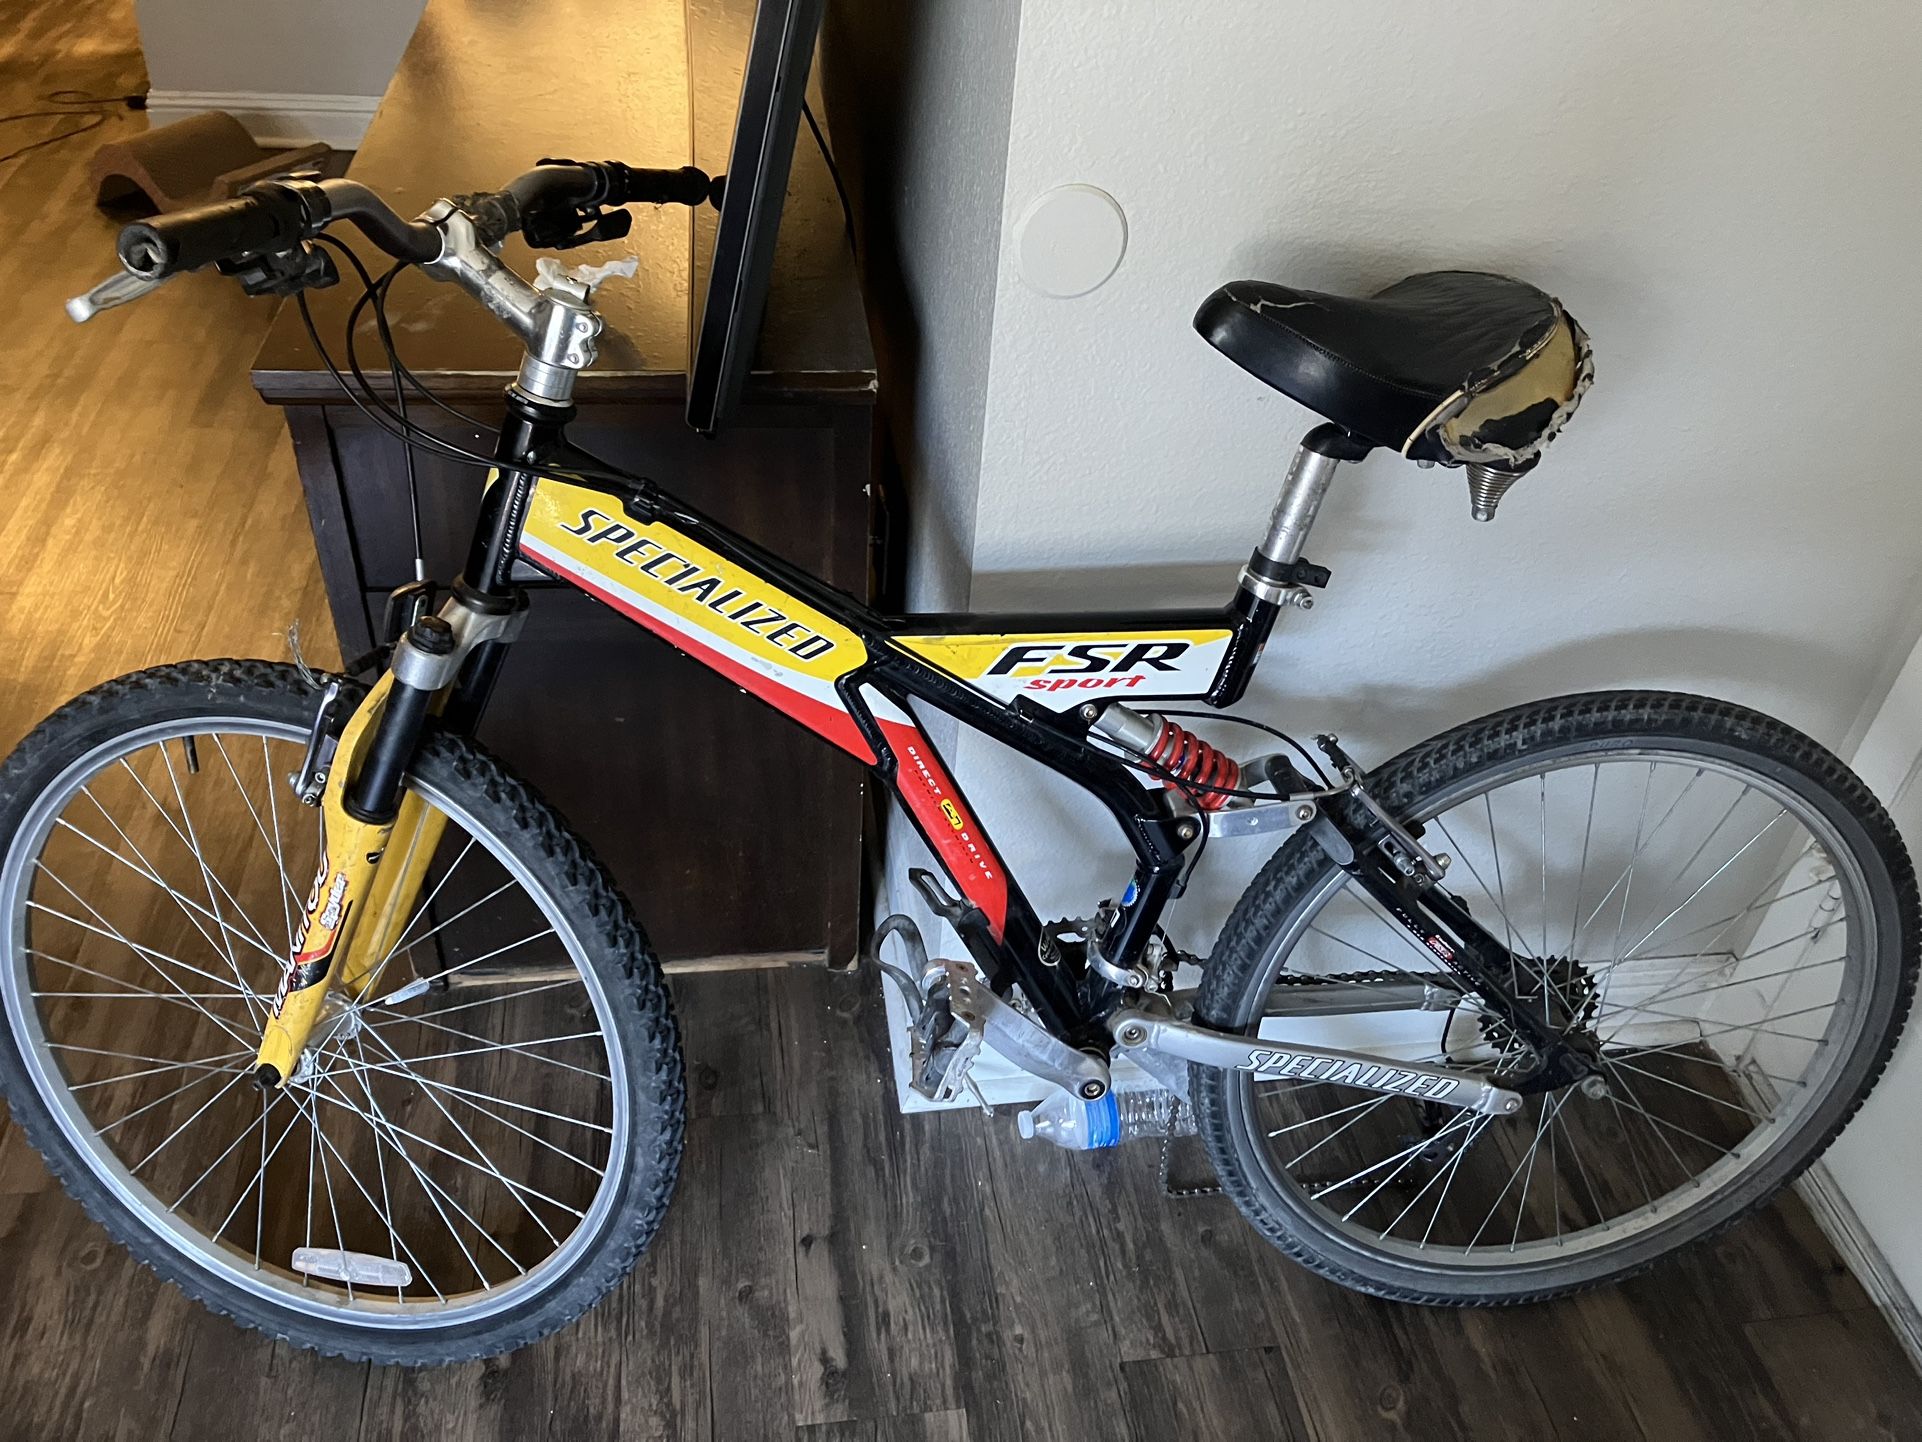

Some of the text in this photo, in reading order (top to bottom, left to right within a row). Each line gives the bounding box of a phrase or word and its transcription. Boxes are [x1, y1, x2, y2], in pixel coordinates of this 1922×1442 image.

[558, 507, 837, 663] SPECIALIZED
[986, 641, 1192, 676] FSR
[1023, 674, 1147, 692] sport
[907, 745, 941, 795] DIRECT
[960, 832, 993, 879] DRIVE
[1235, 1049, 1461, 1100] SPECIALIZED
